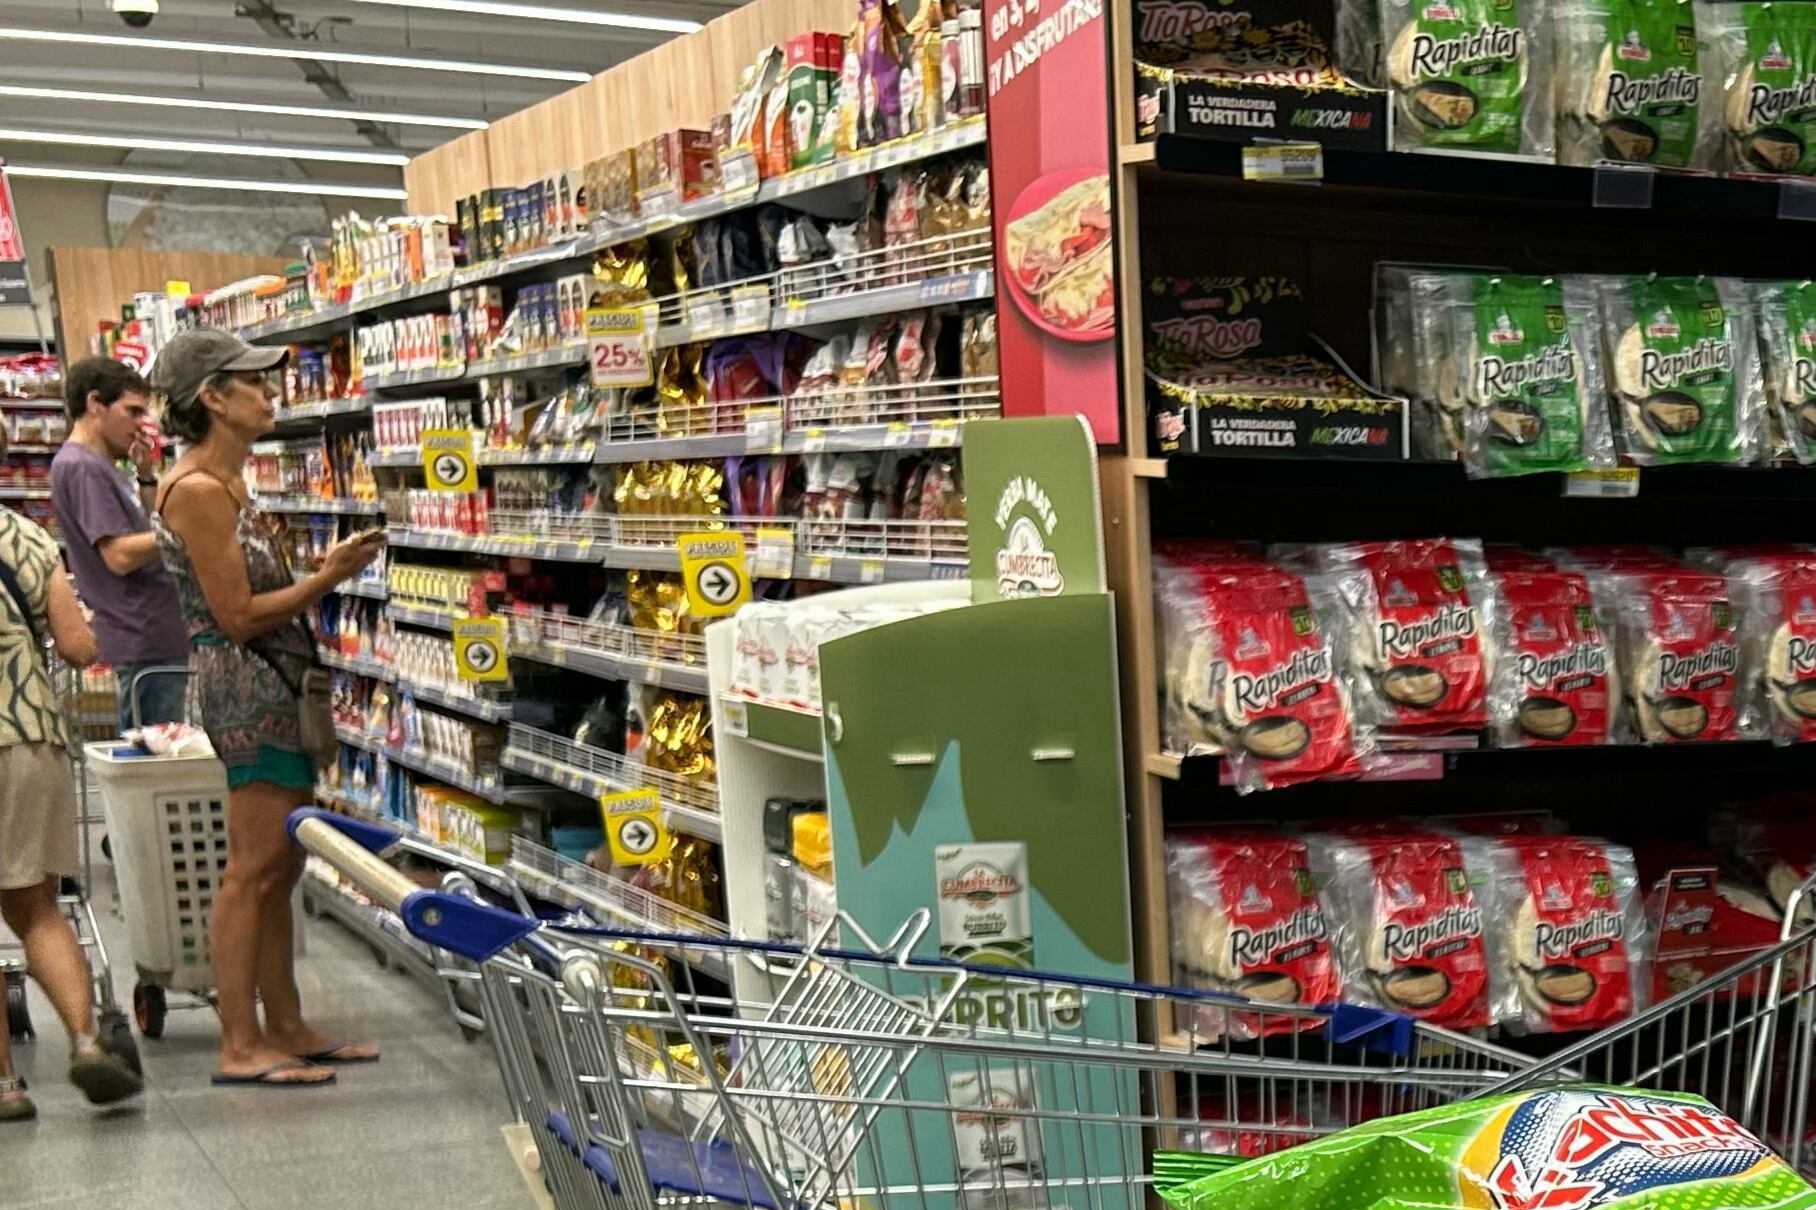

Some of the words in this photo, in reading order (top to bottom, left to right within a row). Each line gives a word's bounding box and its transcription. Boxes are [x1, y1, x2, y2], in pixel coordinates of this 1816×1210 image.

[1411, 25, 1522, 79] Rapiditas
[1207, 96, 1277, 111] VERDADERA
[1606, 69, 1702, 115] Rapiditas
[1189, 108, 1276, 129] TORTILLA
[1291, 108, 1372, 130] MEXICANA
[594, 341, 649, 369] 25%
[1482, 345, 1575, 395] Rapiditas
[1642, 338, 1735, 389] Rapiditas
[1211, 430, 1297, 448] TORTILLA
[1309, 426, 1389, 446] MEXICANA
[1380, 604, 1478, 659] Rapiditas
[1233, 647, 1333, 713] Rapiditas
[1519, 642, 1607, 689] Rapiditas
[1660, 641, 1740, 690] Rapiditas
[1231, 906, 1328, 966] Rapiditas
[1384, 905, 1480, 961] Rapiditas
[1536, 908, 1623, 958] Rapiditas
